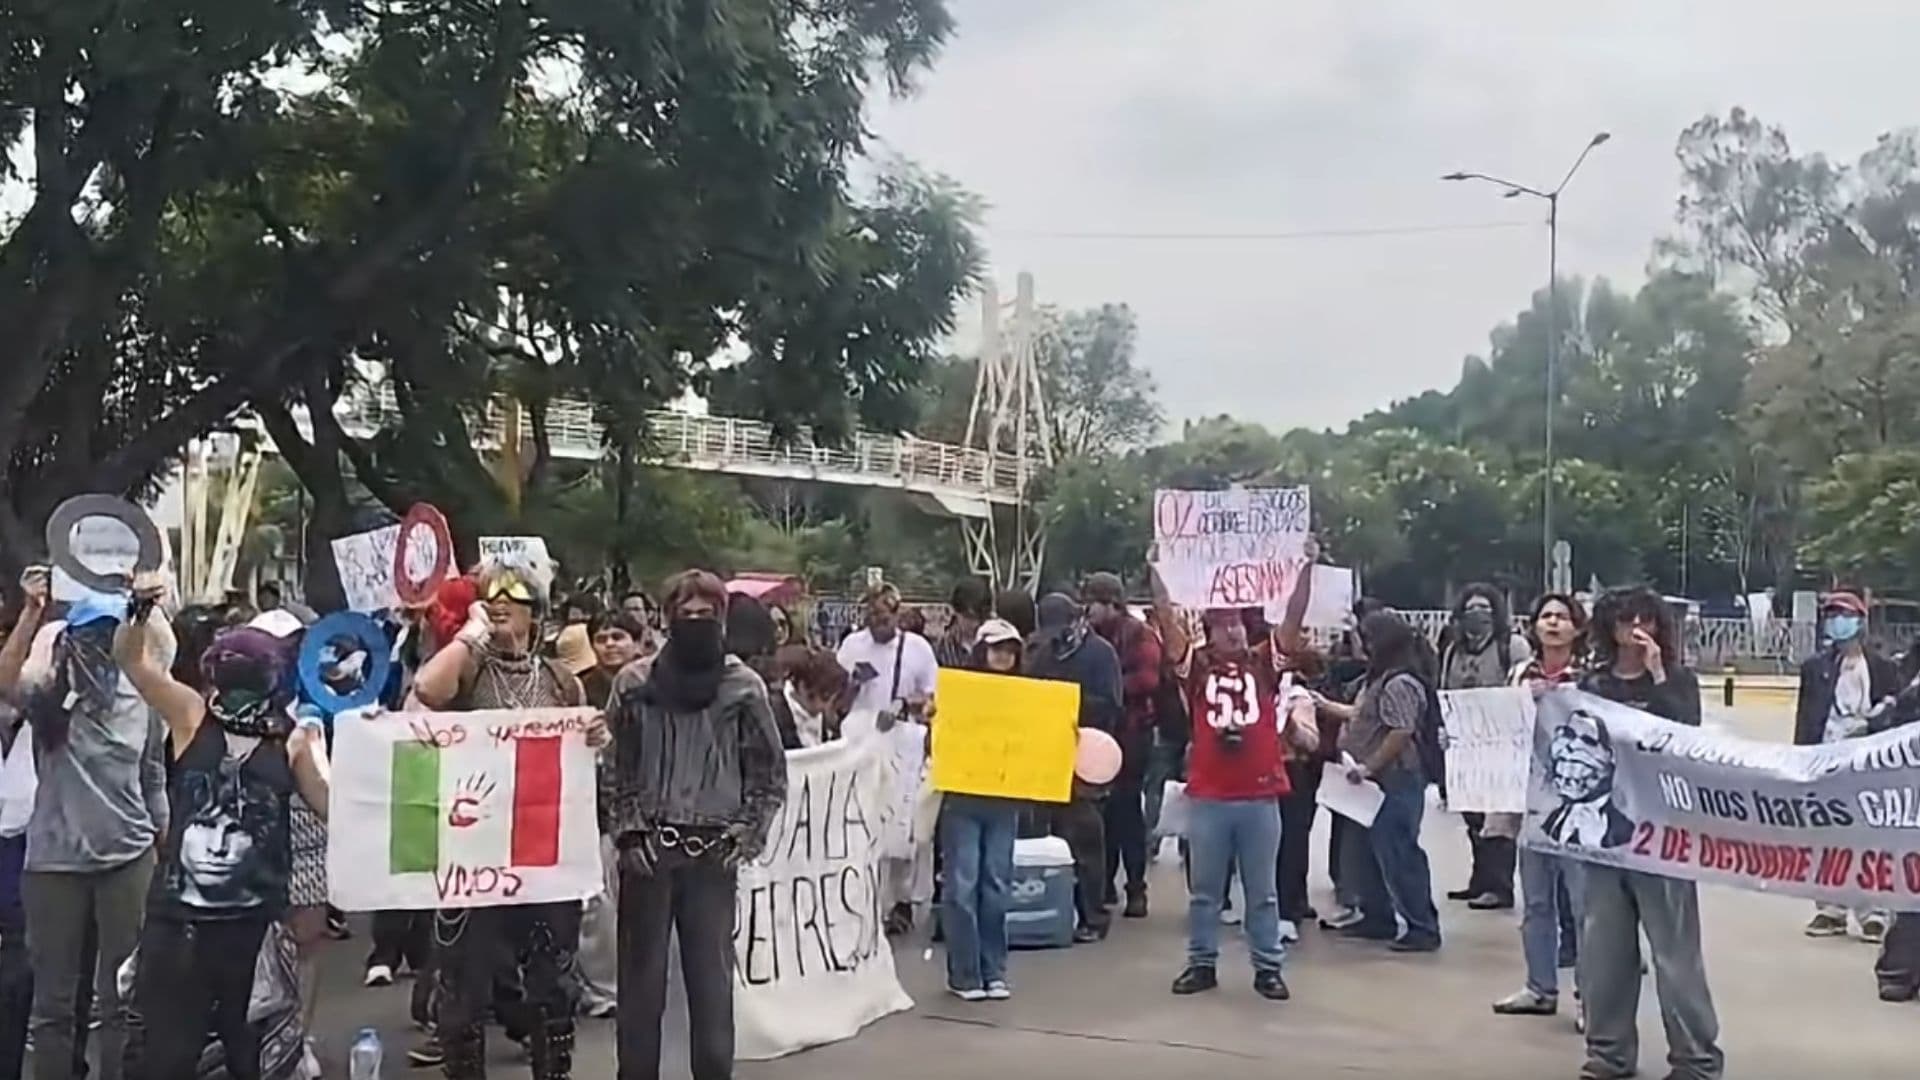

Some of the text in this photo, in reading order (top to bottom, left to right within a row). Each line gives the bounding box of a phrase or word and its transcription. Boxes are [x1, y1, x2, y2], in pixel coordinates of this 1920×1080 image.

[1206, 672, 1260, 728] 53
[1658, 772, 1920, 828] NO nos harás CAL
[1633, 821, 1655, 856] 2
[1660, 826, 1692, 863] DE
[1699, 834, 1812, 882] OCTUBRE
[1815, 846, 1853, 887] NO
[1857, 850, 1894, 893] SE
